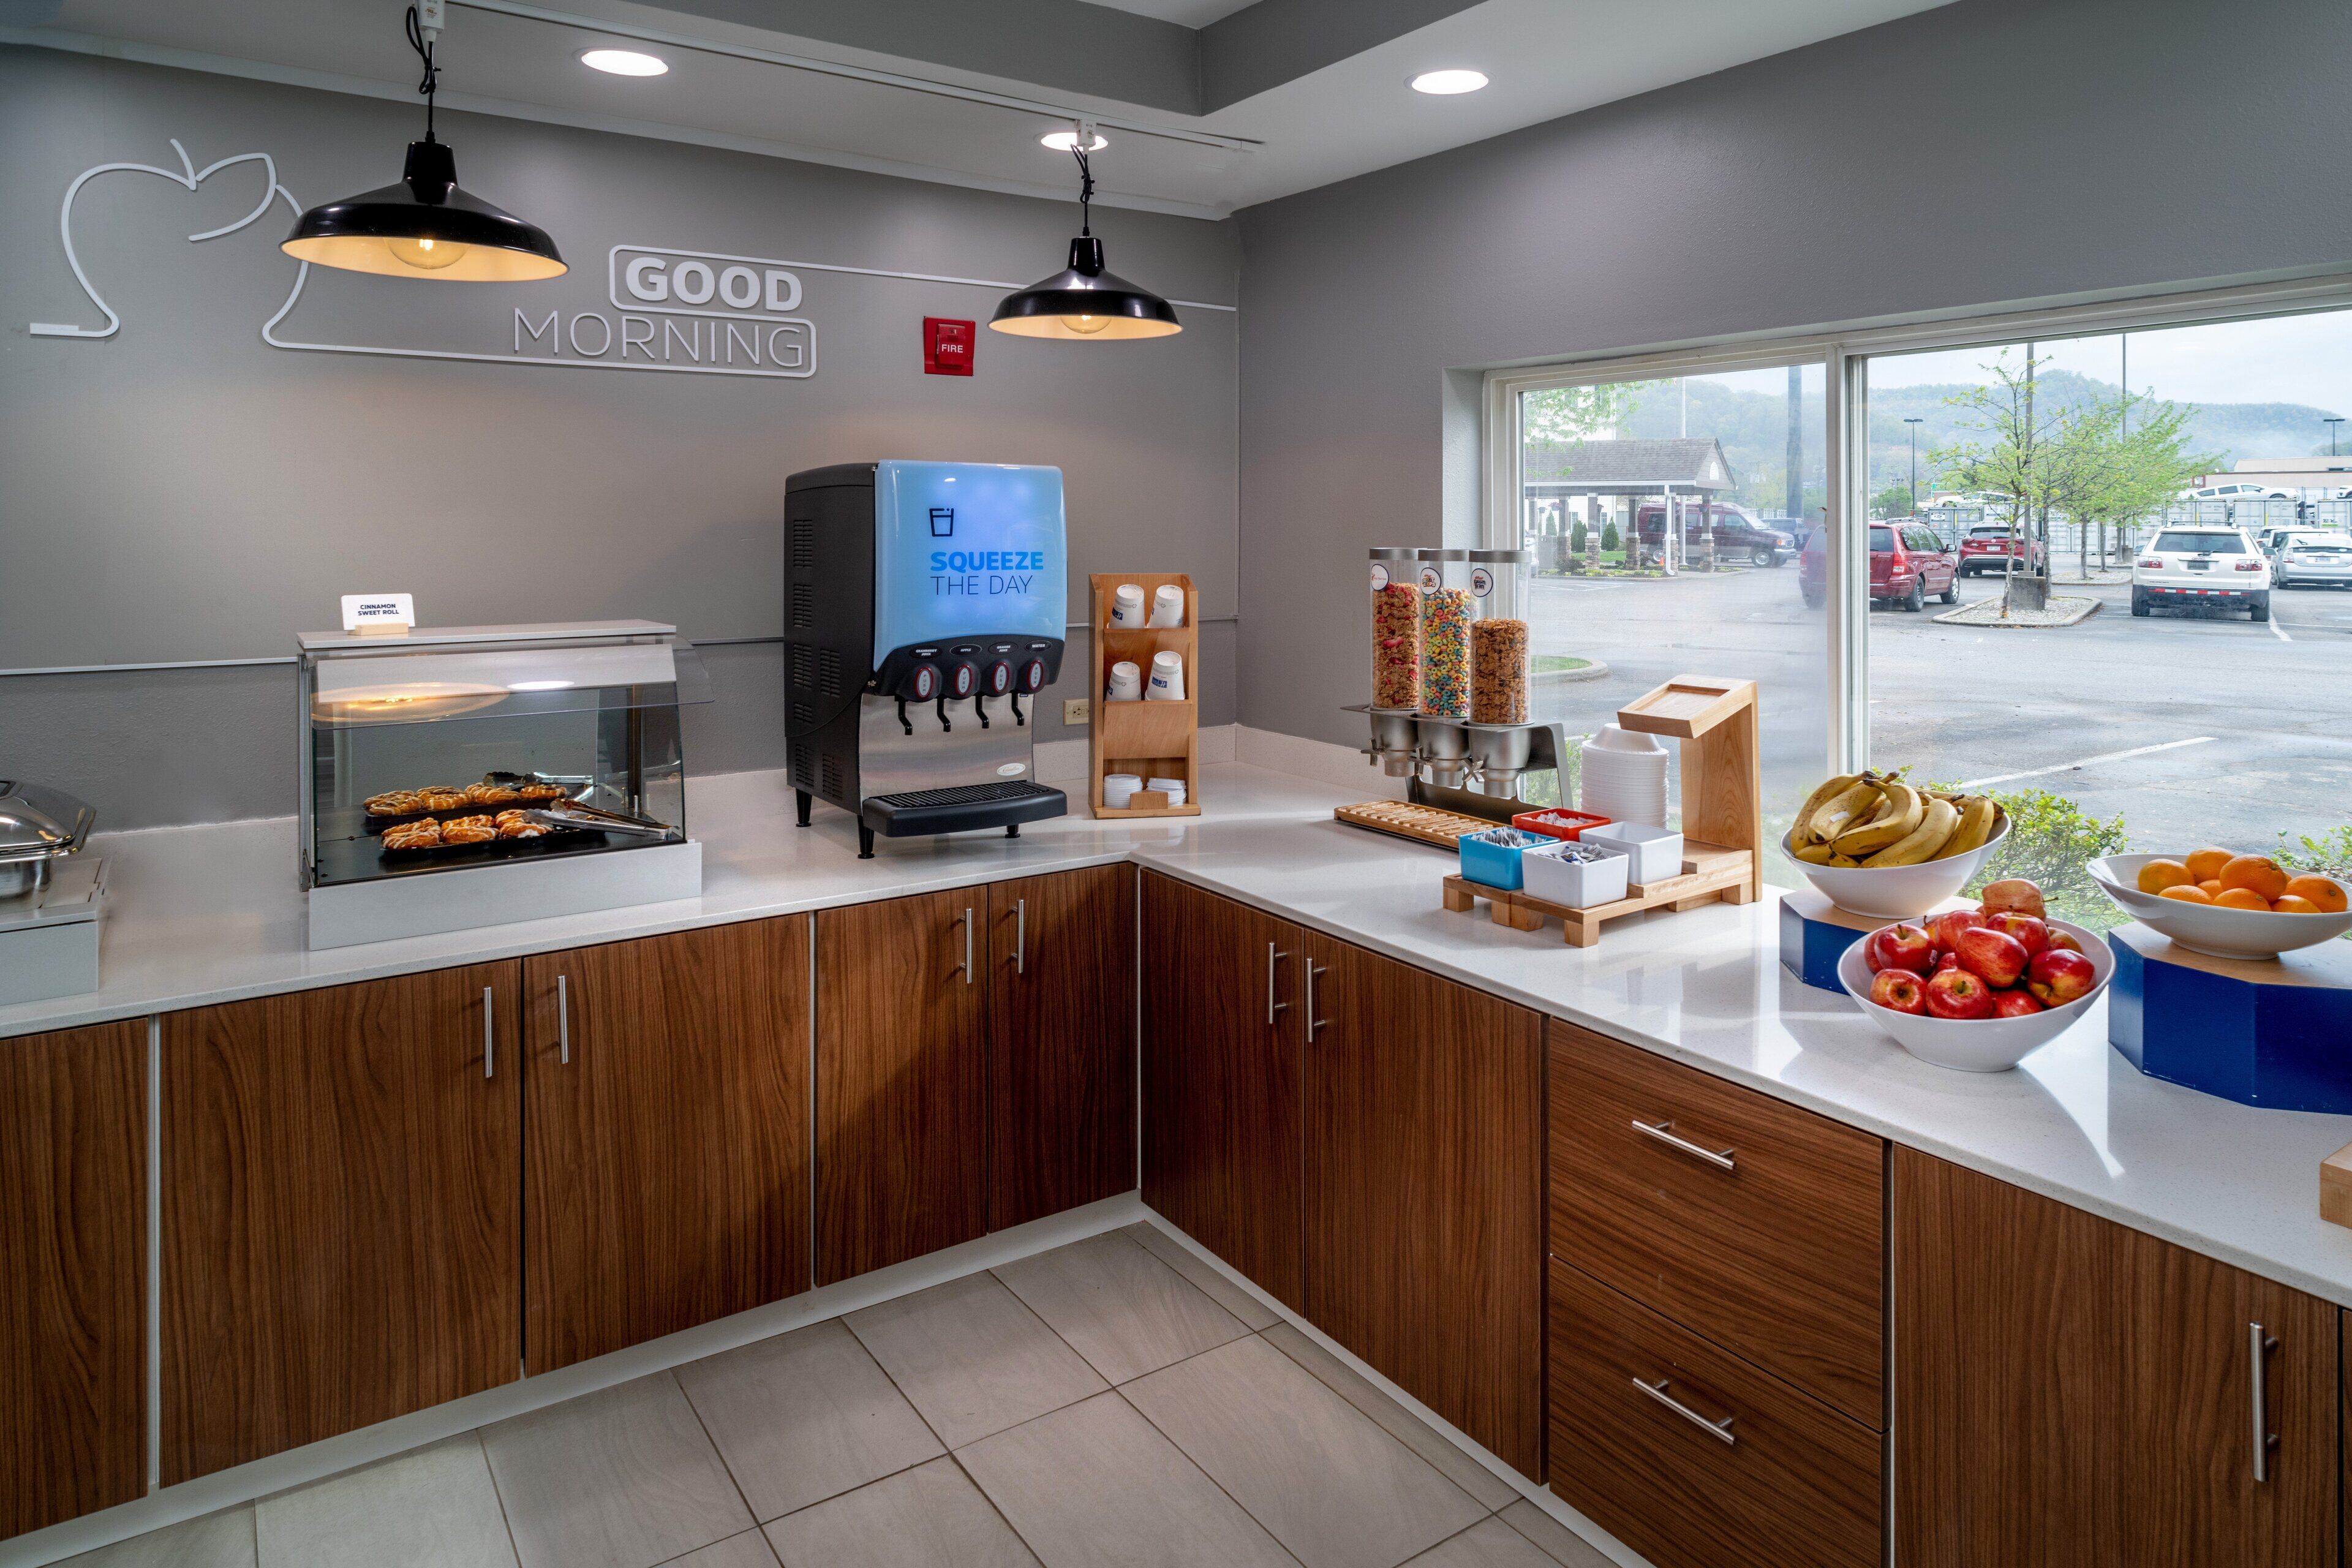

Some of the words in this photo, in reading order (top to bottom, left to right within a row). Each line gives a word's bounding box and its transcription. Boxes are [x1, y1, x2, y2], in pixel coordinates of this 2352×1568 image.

[625, 256, 803, 311] GOOD
[513, 307, 803, 368] MORNING
[941, 344, 963, 353] FIRE
[930, 551, 1044, 573] SQUEEZE
[930, 575, 979, 595] THE
[989, 575, 1033, 595] DAY
